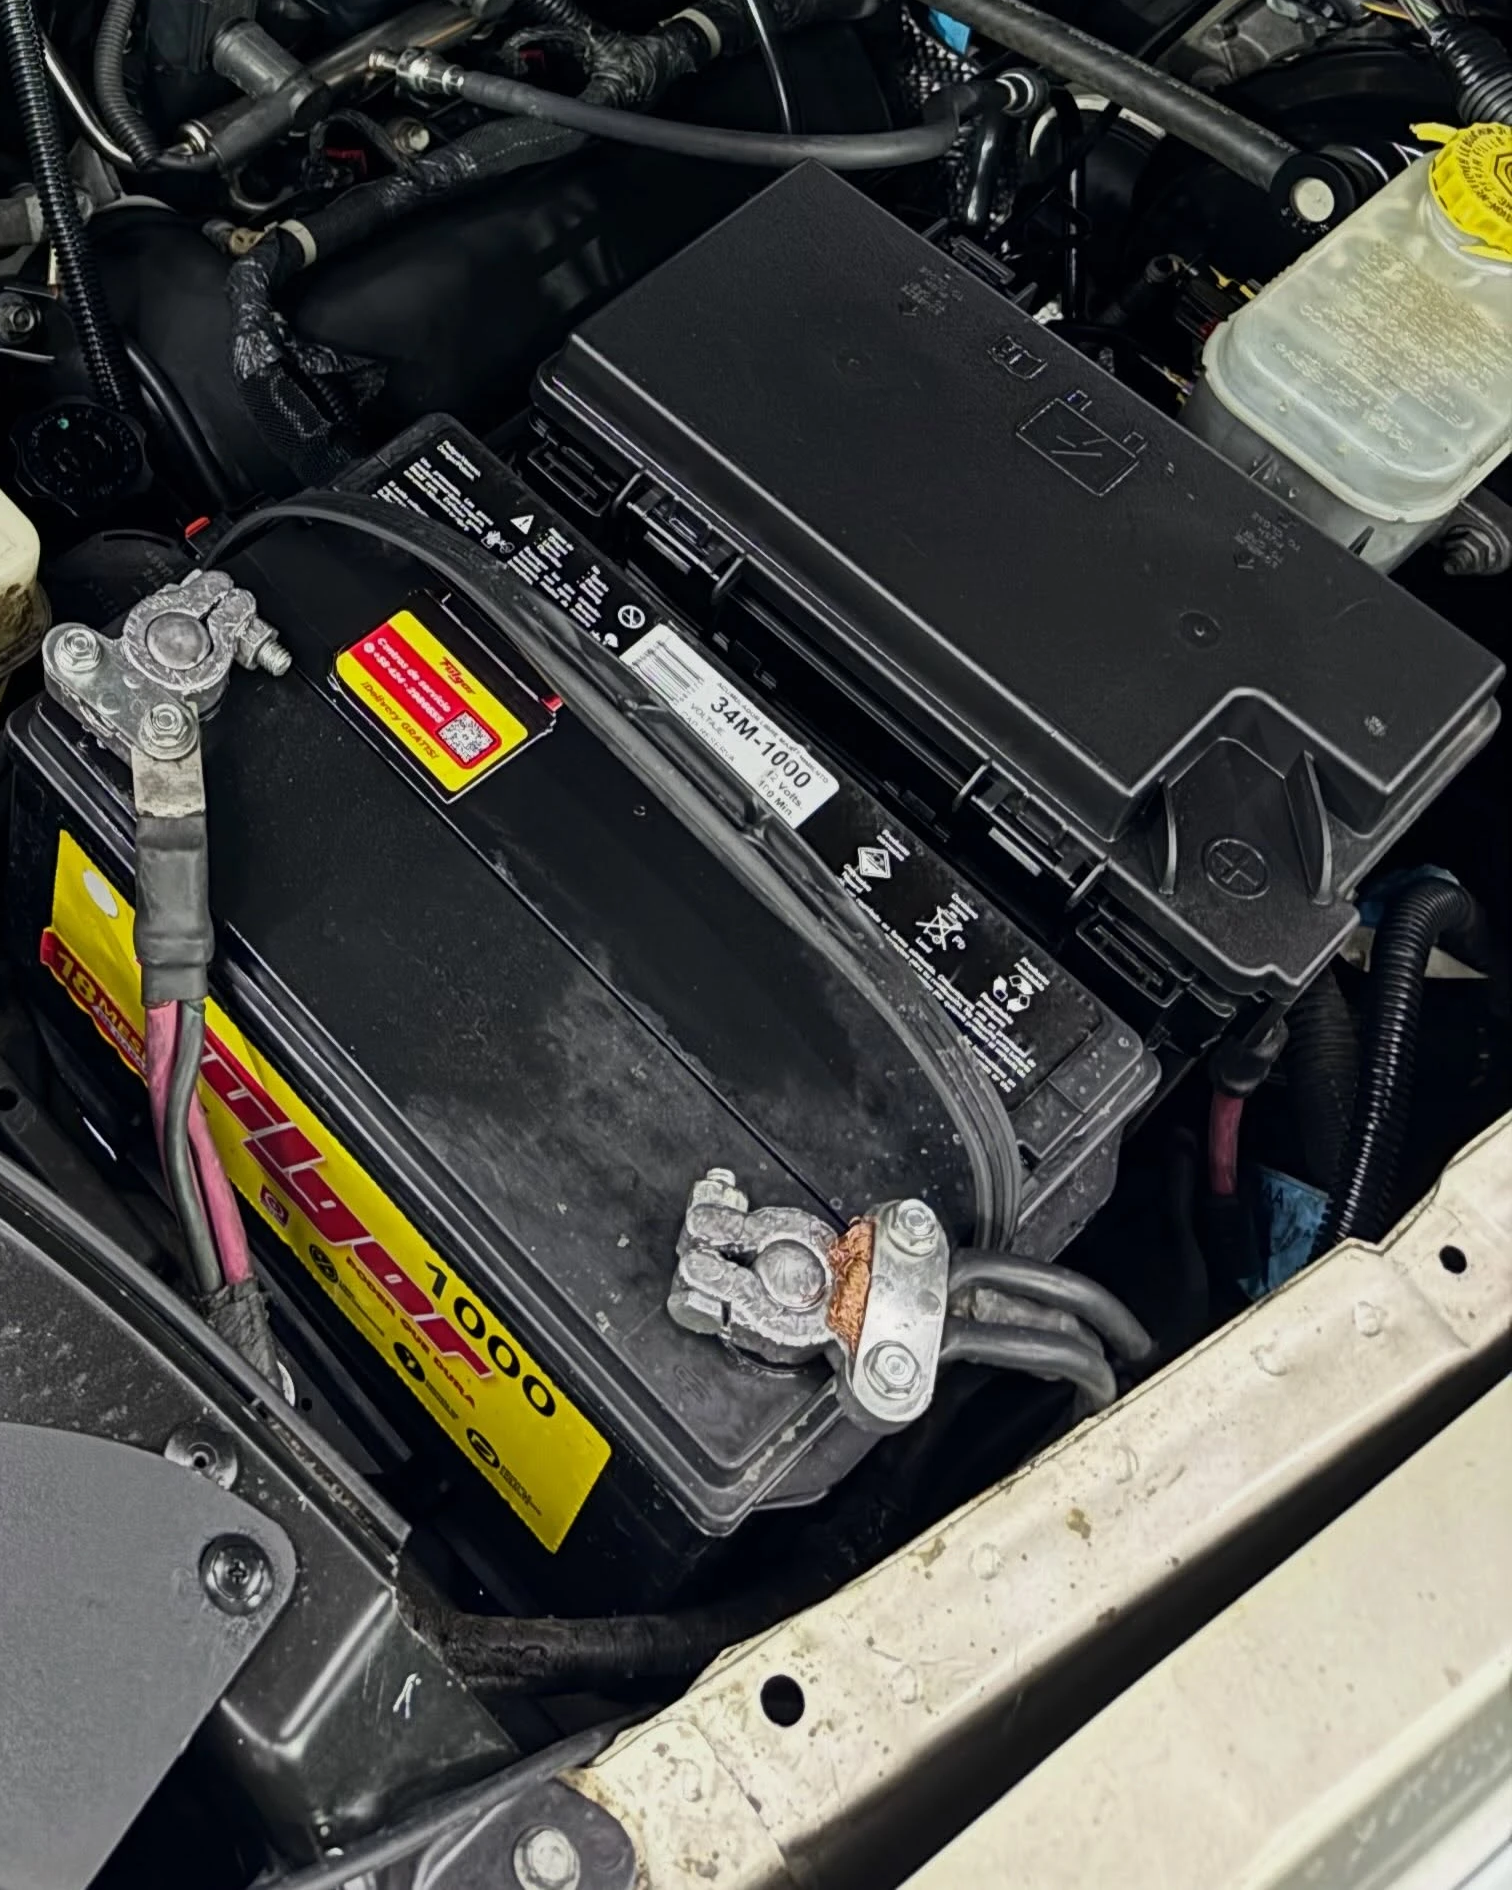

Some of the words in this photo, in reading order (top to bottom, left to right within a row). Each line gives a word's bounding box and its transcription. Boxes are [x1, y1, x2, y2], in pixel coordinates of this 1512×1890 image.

[375, 635, 409, 670] Centros
[405, 666, 421, 681] de
[417, 678, 452, 713] servicio
[359, 680, 402, 721] ¡Delivery
[400, 721, 439, 760] GRATIS!
[689, 701, 725, 736] VOLTAJE
[708, 694, 813, 790] 34M-1000
[765, 768, 778, 782] 12
[776, 780, 805, 810] Volts.
[772, 795, 795, 819] Min.
[951, 934, 967, 951] Pb
[51, 948, 101, 1005] 18
[344, 1256, 397, 1317] PODER
[397, 1317, 432, 1355] QUE
[431, 1356, 478, 1409] DURA
[415, 1257, 561, 1421] 1000
